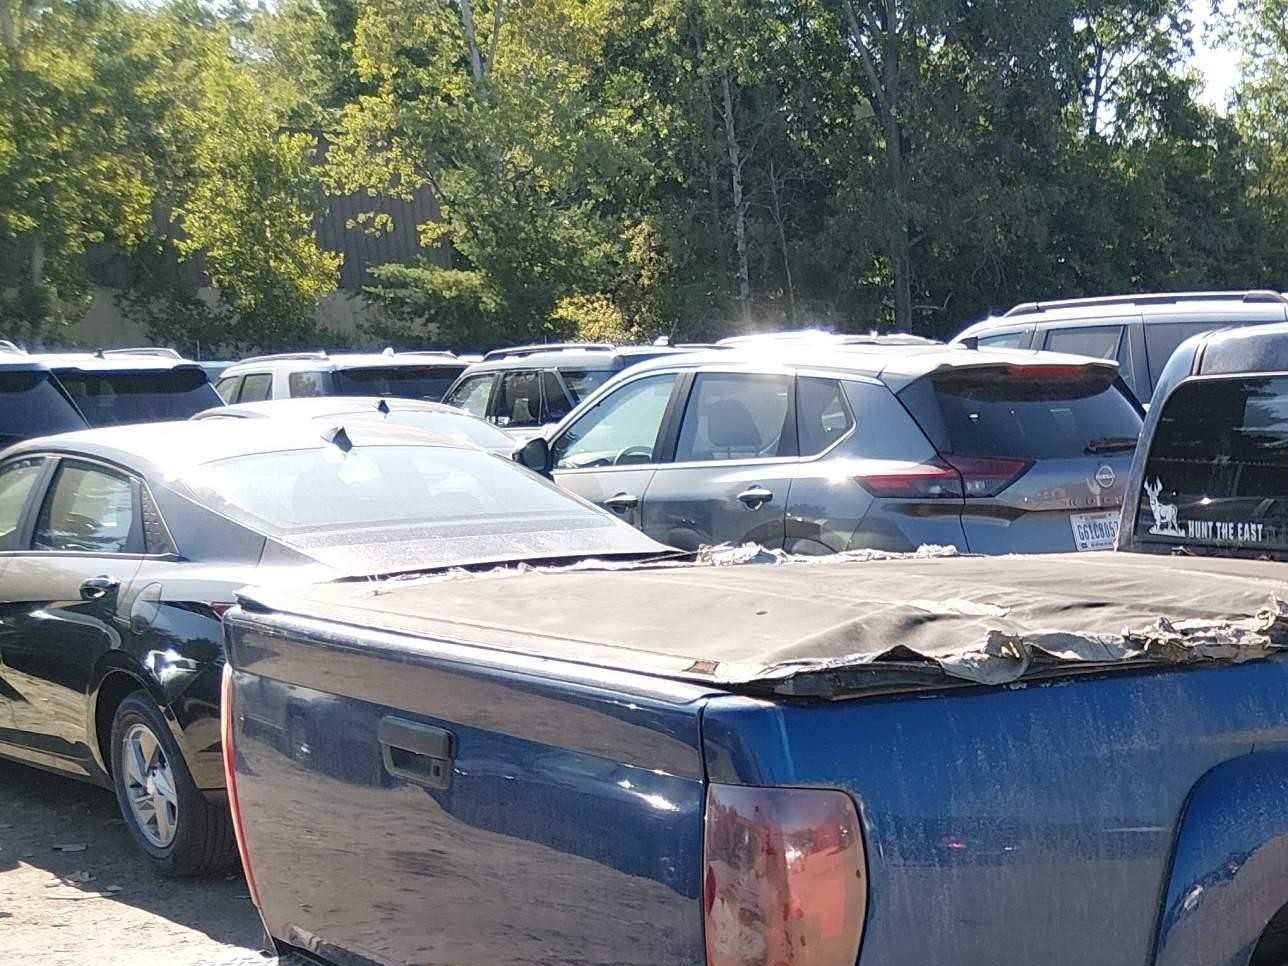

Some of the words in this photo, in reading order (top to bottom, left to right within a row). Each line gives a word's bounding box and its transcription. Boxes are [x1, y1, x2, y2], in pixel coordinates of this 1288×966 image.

[1188, 520, 1213, 539] HUNT
[1216, 521, 1234, 541] THE
[1237, 523, 1263, 542] EAST
